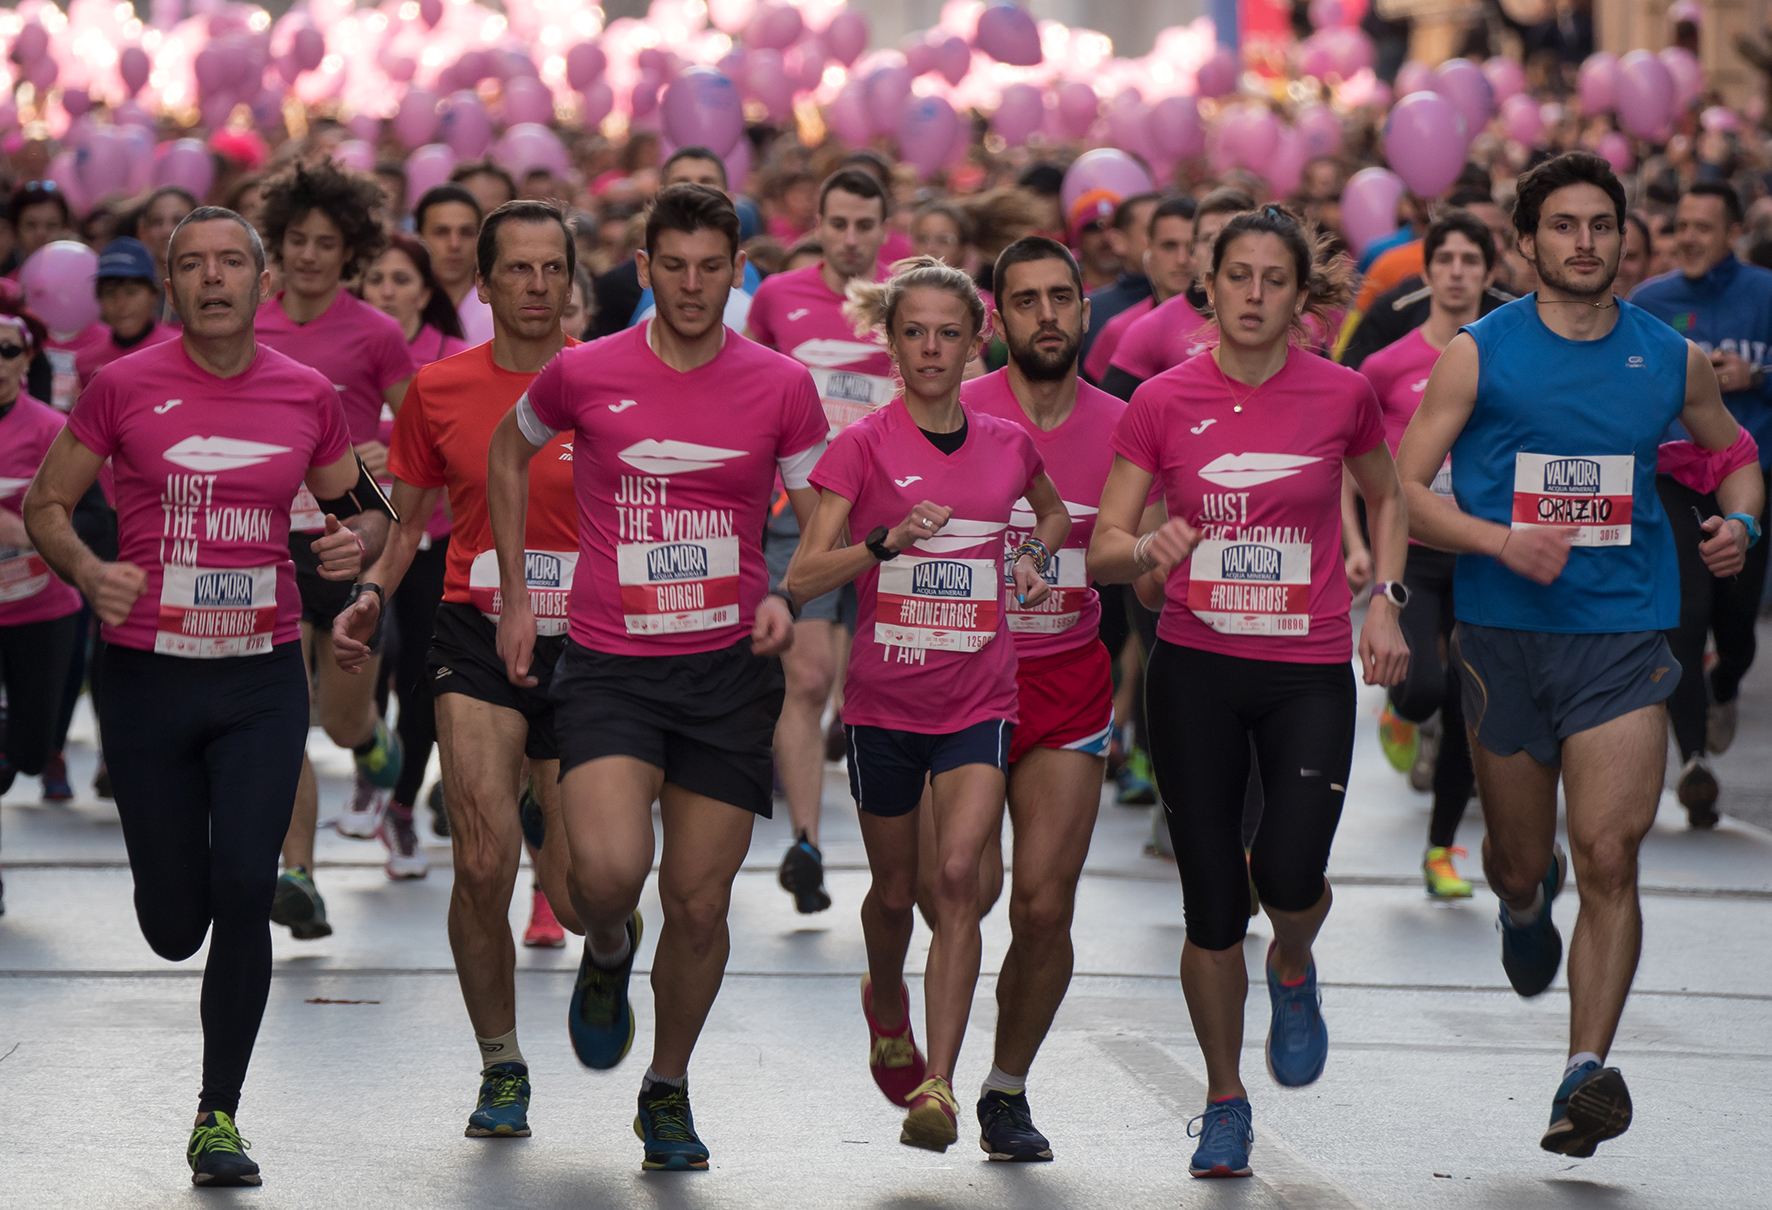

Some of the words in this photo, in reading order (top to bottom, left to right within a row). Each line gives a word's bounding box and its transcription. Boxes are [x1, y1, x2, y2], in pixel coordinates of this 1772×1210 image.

[1546, 460, 1599, 486] VALMORA
[160, 473, 217, 506] JUST
[614, 474, 670, 506] JUST
[1547, 485, 1568, 493] ACQUA
[1199, 492, 1250, 524] JUST
[1537, 492, 1612, 524] ORAZIO
[161, 503, 199, 539] THE
[205, 506, 273, 542] WOMAN
[615, 506, 654, 541] THE
[660, 508, 733, 542] WOMAN
[1236, 526, 1307, 544] WOMAN
[1600, 528, 1620, 541] 3015
[160, 538, 166, 567] I
[171, 539, 198, 568] AM
[524, 554, 559, 580] MORA
[648, 544, 706, 574] VALMORA
[1223, 545, 1279, 574] VALMORA
[197, 573, 251, 600] VALMORA
[915, 562, 971, 590] VALMORA
[656, 582, 705, 612] GIORGIO
[916, 587, 938, 595] ACQUA
[938, 589, 968, 598] MINERALE
[1210, 584, 1289, 612] #RUNENROSE
[182, 609, 258, 637] #RUNENROSE
[900, 598, 978, 629] #RUNENROSE
[896, 646, 926, 666] AM
